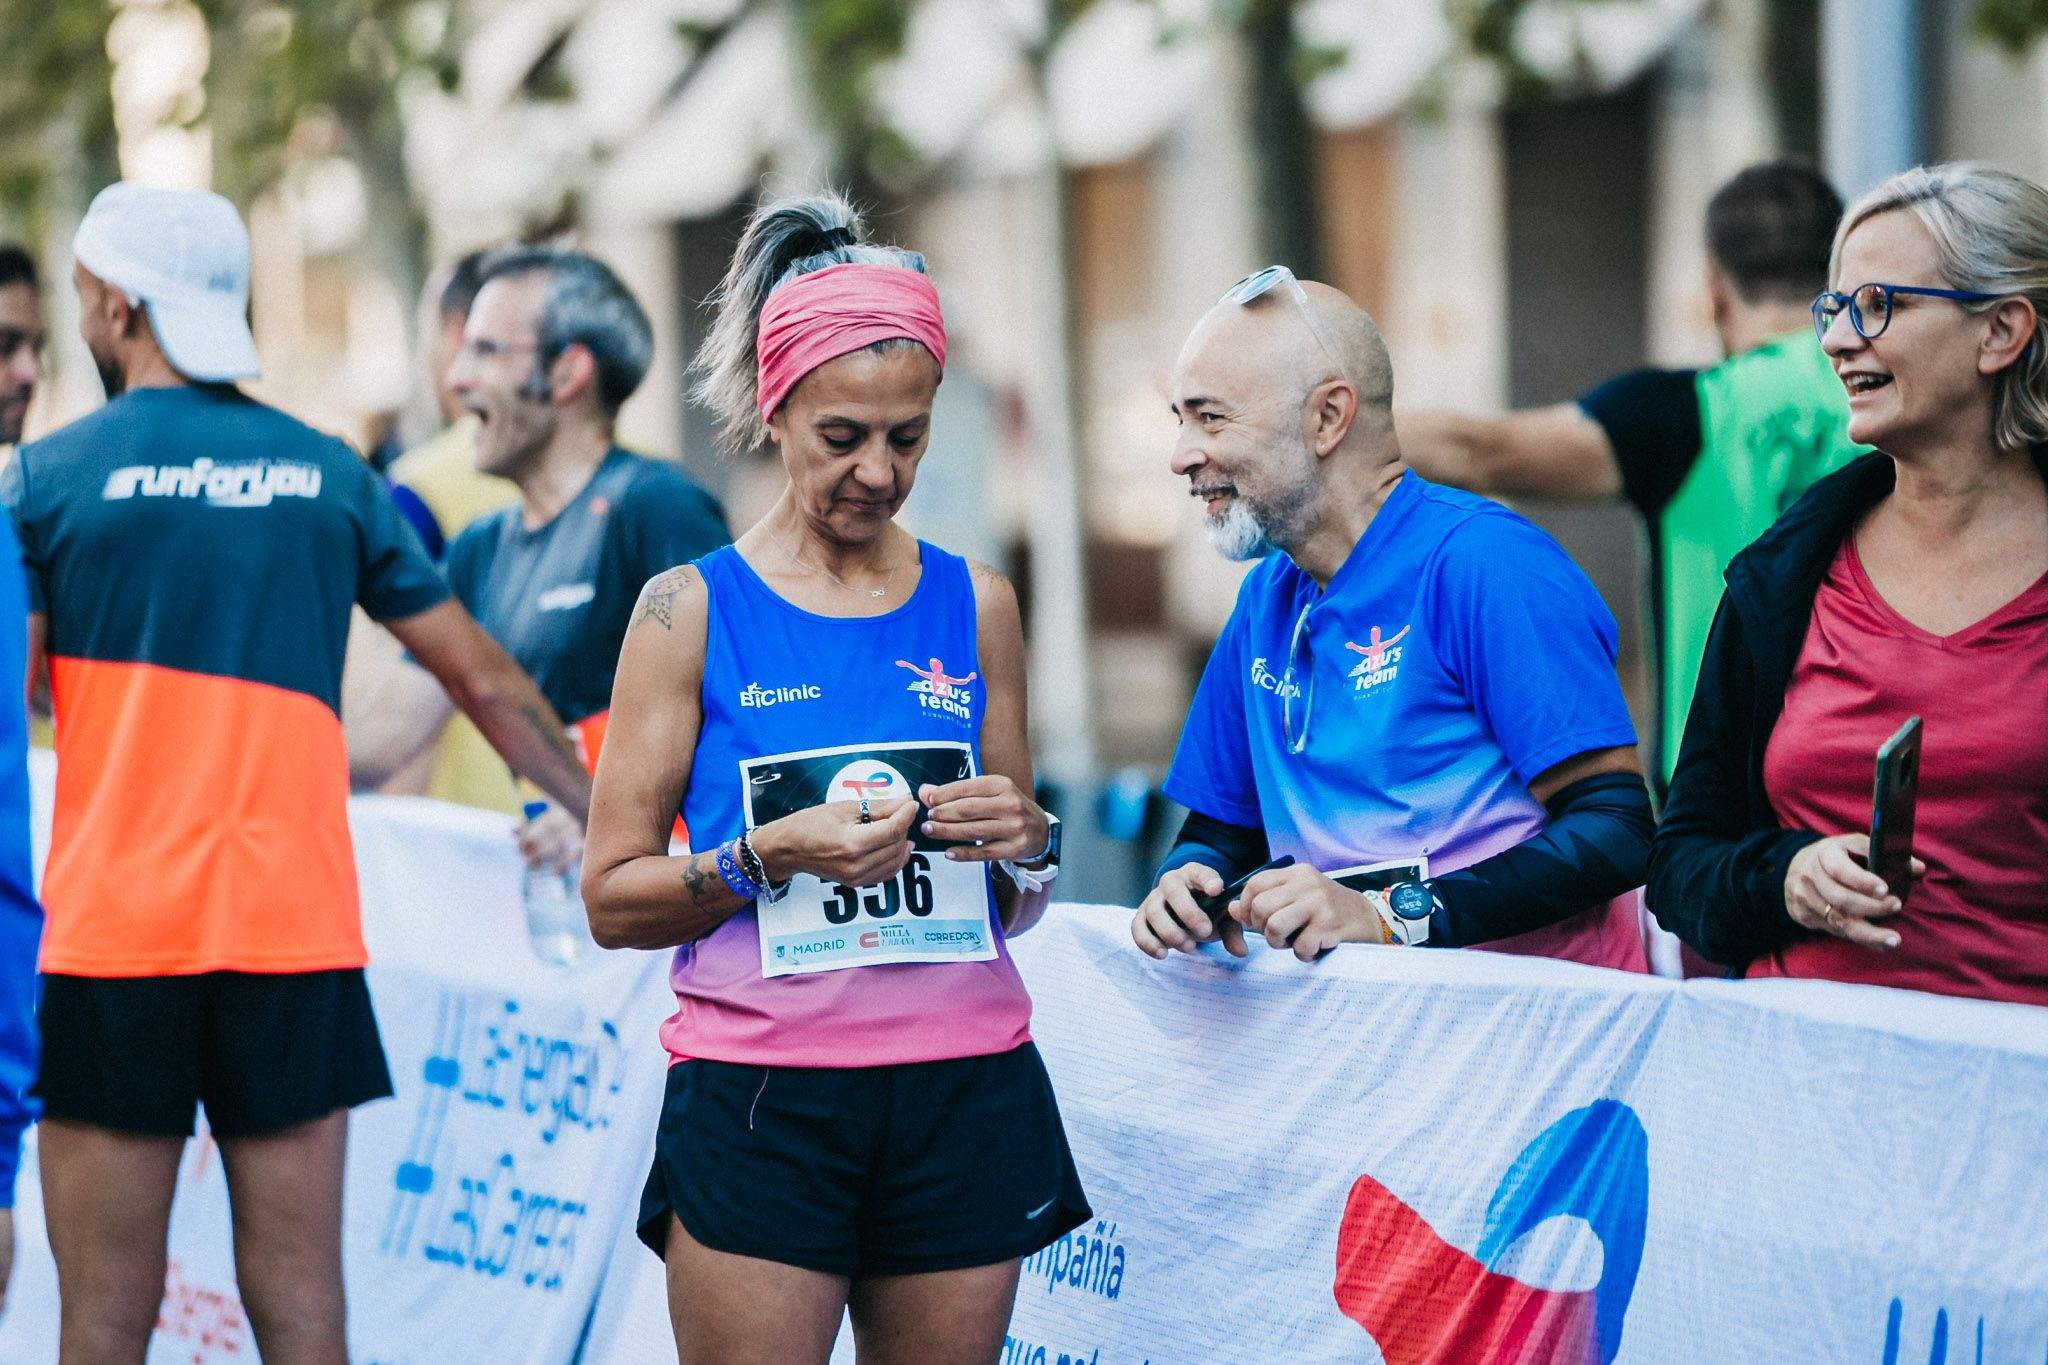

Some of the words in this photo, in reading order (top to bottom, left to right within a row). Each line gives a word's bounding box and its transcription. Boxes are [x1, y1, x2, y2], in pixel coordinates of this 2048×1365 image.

[101, 456, 322, 507] runforyou
[1355, 665, 1398, 691] team
[919, 692, 971, 720] team
[793, 939, 845, 955] MADRID
